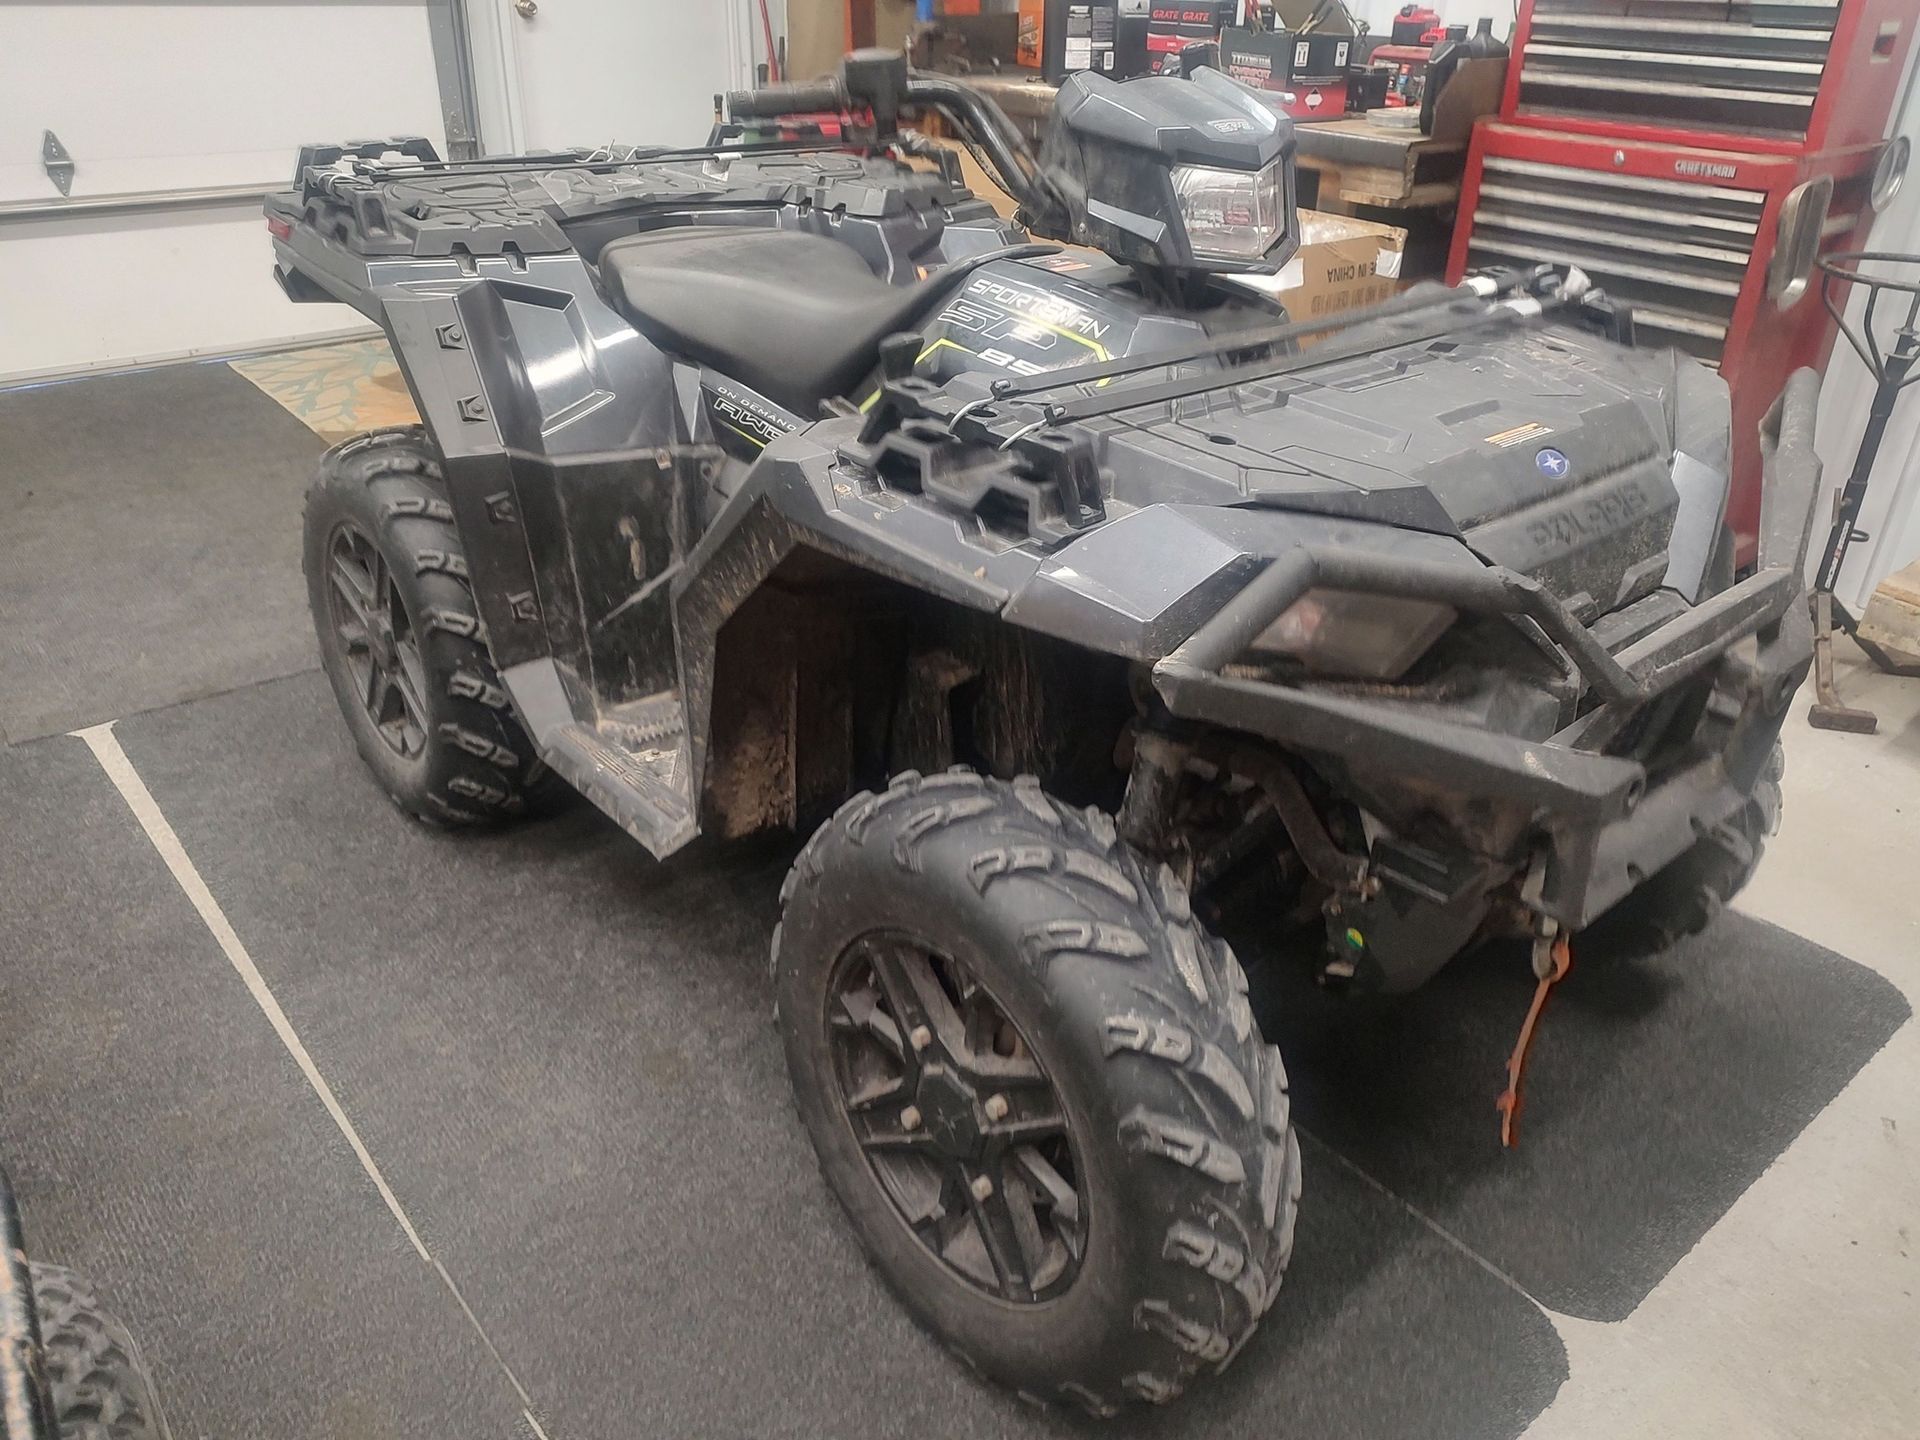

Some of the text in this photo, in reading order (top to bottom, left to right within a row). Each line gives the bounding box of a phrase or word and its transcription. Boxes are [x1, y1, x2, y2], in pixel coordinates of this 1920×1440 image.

[1674, 160, 1737, 179] CRAFTSMAN
[1327, 265, 1355, 283] CHINA
[1358, 263, 1367, 278] IN
[968, 278, 1110, 338] SPORTSMAN
[717, 386, 797, 432] ON DEMAND
